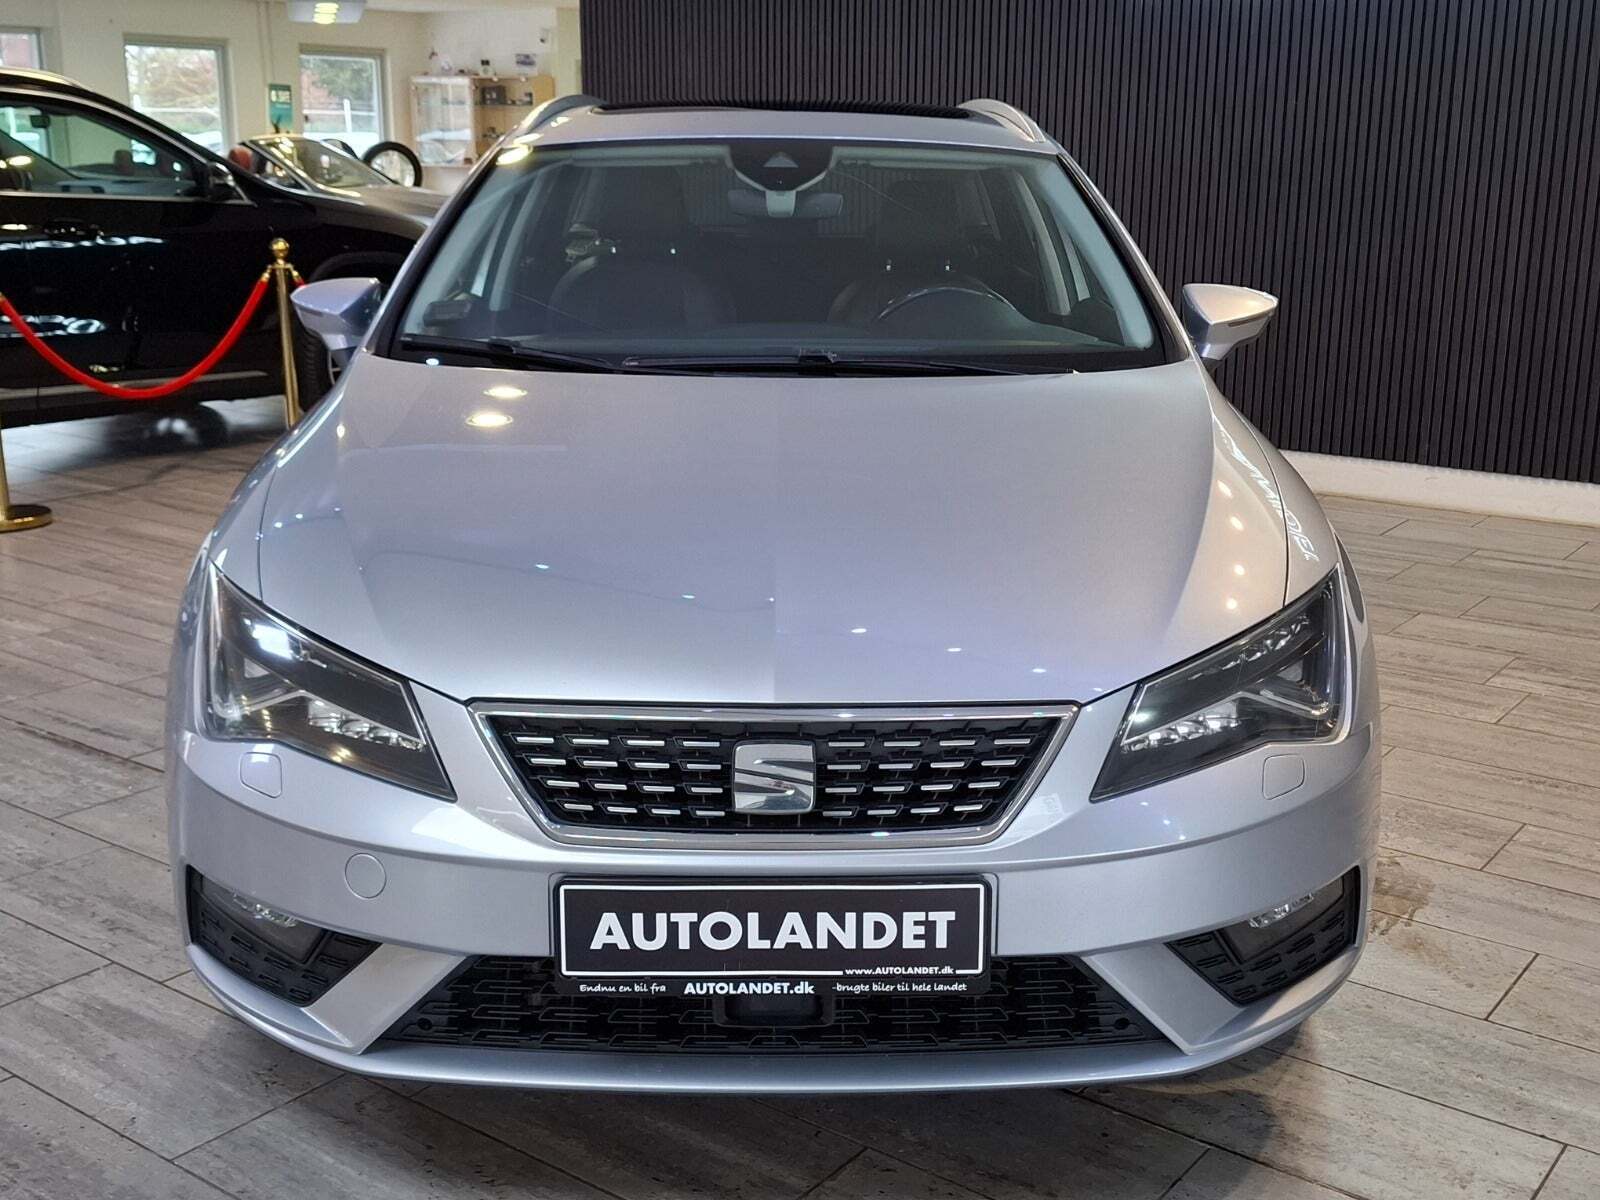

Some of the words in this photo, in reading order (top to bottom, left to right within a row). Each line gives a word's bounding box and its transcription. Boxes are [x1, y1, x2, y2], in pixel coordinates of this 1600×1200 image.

[589, 911, 956, 951] AUTOLANDET
[845, 966, 954, 975] www.AUTOLANDET.dk
[579, 983, 617, 993] Endnu
[618, 985, 632, 993] en
[634, 983, 648, 993] bil
[649, 983, 667, 994] fra
[683, 982, 815, 995] AUTOLANDET.dk
[872, 982, 896, 992] biler
[896, 982, 910, 992] til
[912, 982, 932, 992] hele
[933, 982, 968, 992] landet
